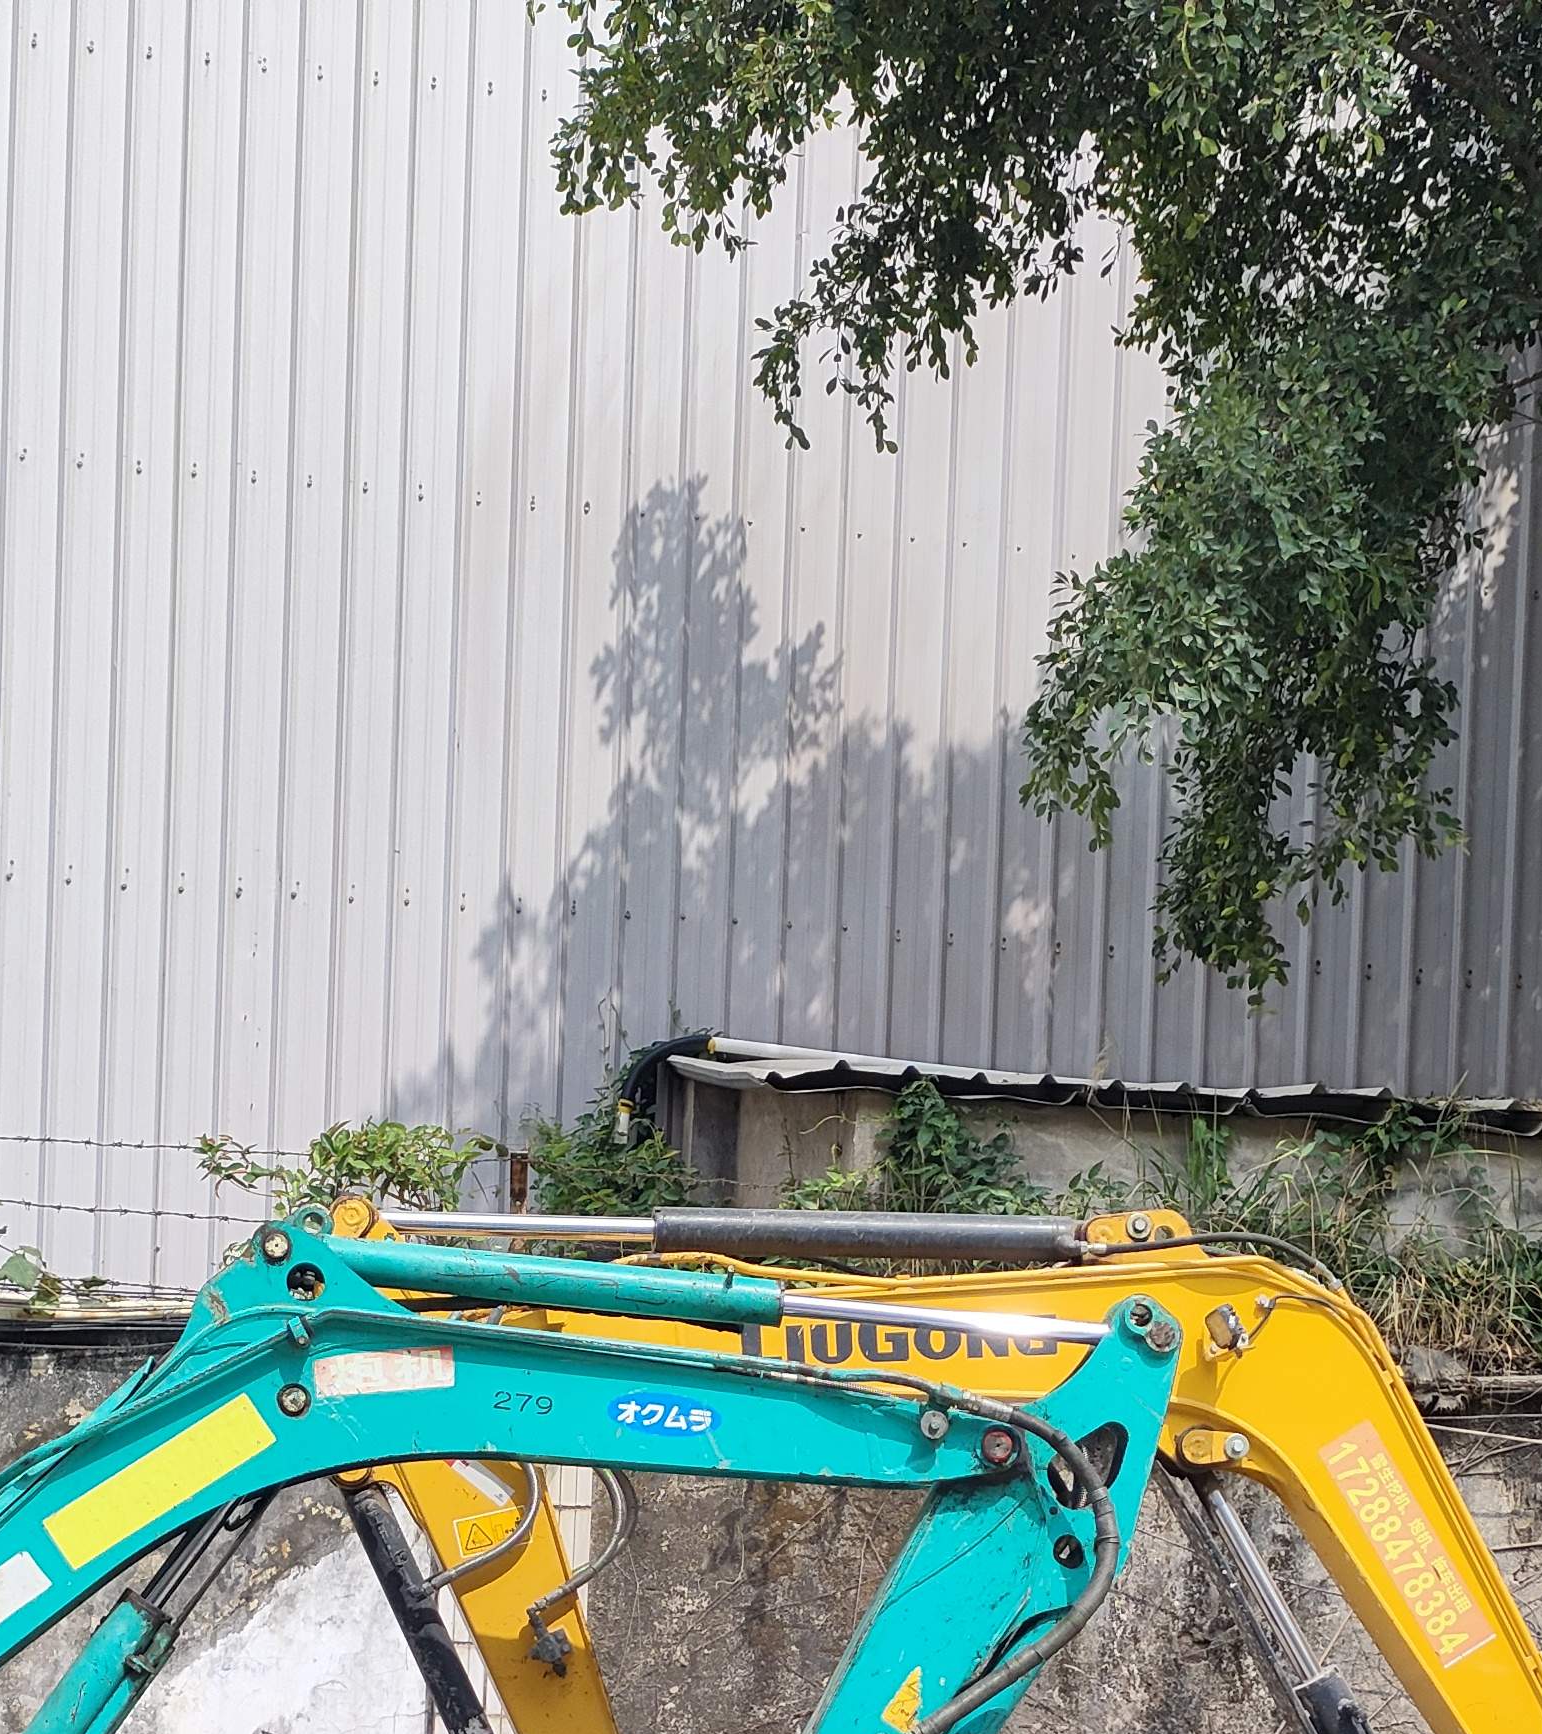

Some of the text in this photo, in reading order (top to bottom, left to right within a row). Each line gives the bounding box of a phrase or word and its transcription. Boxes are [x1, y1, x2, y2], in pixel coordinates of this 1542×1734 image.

[493, 1390, 554, 1415] 279
[616, 1400, 712, 1433] オクムラ
[1328, 1441, 1470, 1656] 17288478384
